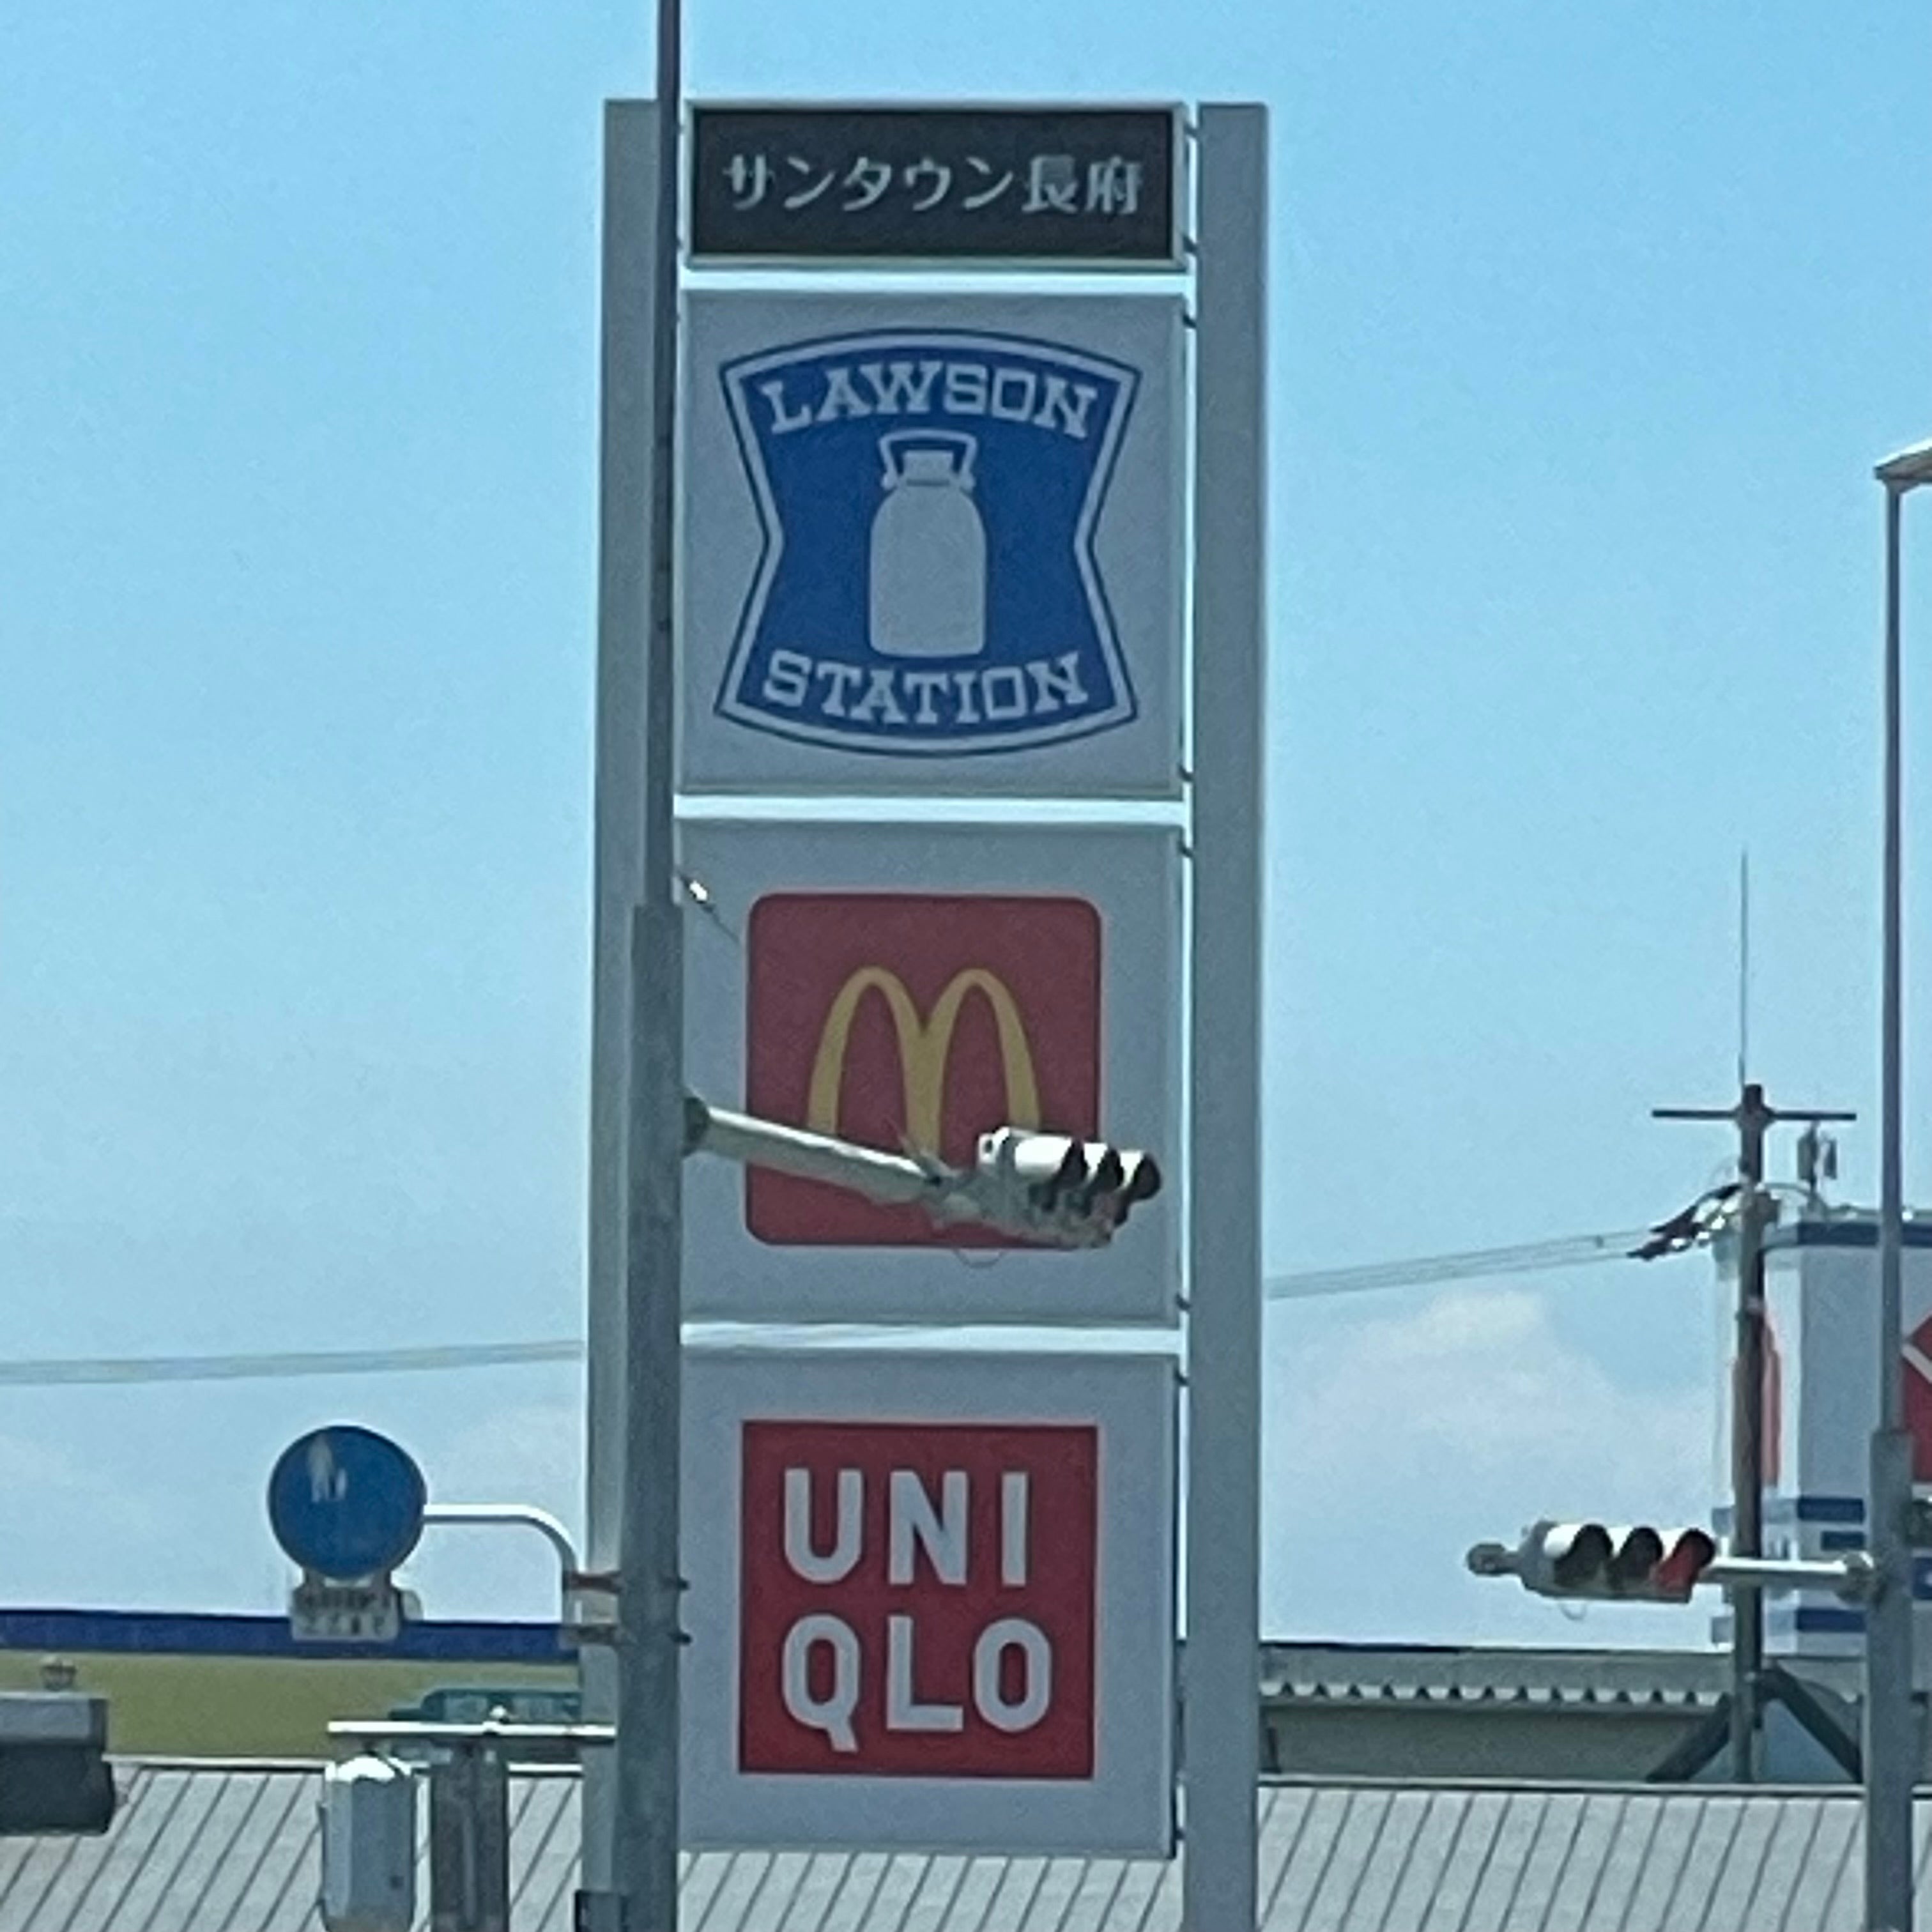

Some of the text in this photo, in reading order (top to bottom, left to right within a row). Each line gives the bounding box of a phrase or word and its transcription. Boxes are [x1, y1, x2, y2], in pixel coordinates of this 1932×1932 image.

[723, 154, 1144, 215] サンタウン長府
[761, 360, 1098, 440] LAWSON
[762, 648, 1089, 724] STATION
[784, 1468, 1027, 1587] UNI
[781, 1613, 1052, 1752] QLO
